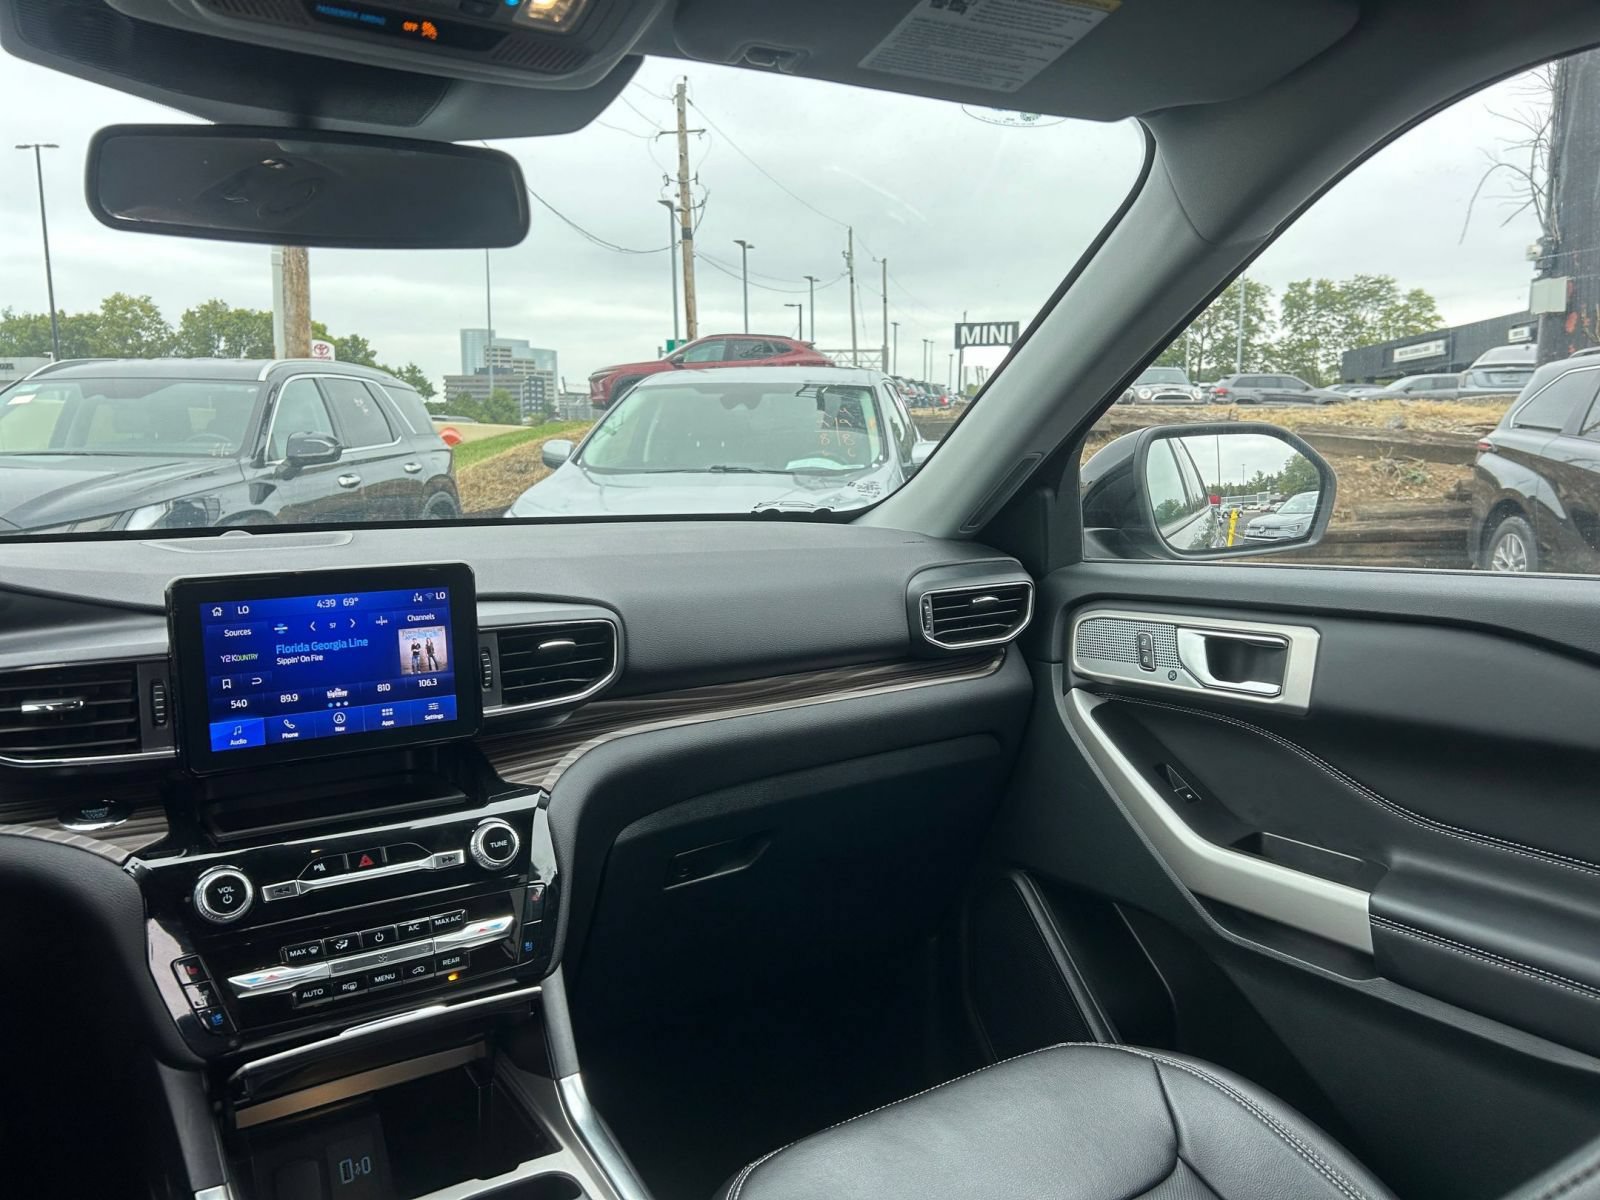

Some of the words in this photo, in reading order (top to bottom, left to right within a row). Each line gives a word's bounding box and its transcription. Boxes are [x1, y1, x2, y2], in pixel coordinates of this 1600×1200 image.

[402, 20, 418, 32] OFF
[961, 324, 1013, 345] MINI
[435, 591, 446, 600] LO
[316, 598, 336, 608] 4:39
[342, 597, 359, 606] 69°
[237, 605, 250, 615] LO
[407, 613, 435, 622] Channels
[224, 629, 252, 637] Sources
[275, 642, 310, 655] Florida
[311, 639, 347, 651] Georgia
[348, 637, 368, 648] Line
[276, 656, 300, 666] Sippin'
[300, 655, 310, 663] On
[310, 654, 323, 662] Fire
[377, 683, 391, 692] 810
[418, 678, 438, 687] 106.3
[280, 693, 298, 703] 89.9
[230, 699, 248, 709] 540
[424, 713, 444, 721] Settings
[489, 839, 508, 849] TUNE
[217, 885, 235, 894] VOL
[435, 917, 450, 926] MAX
[450, 914, 462, 923] A/C
[408, 923, 420, 932] A/C
[289, 948, 307, 958] MAX
[442, 956, 460, 966] REAR
[374, 972, 396, 983] MENU
[302, 988, 324, 998] AUTO
